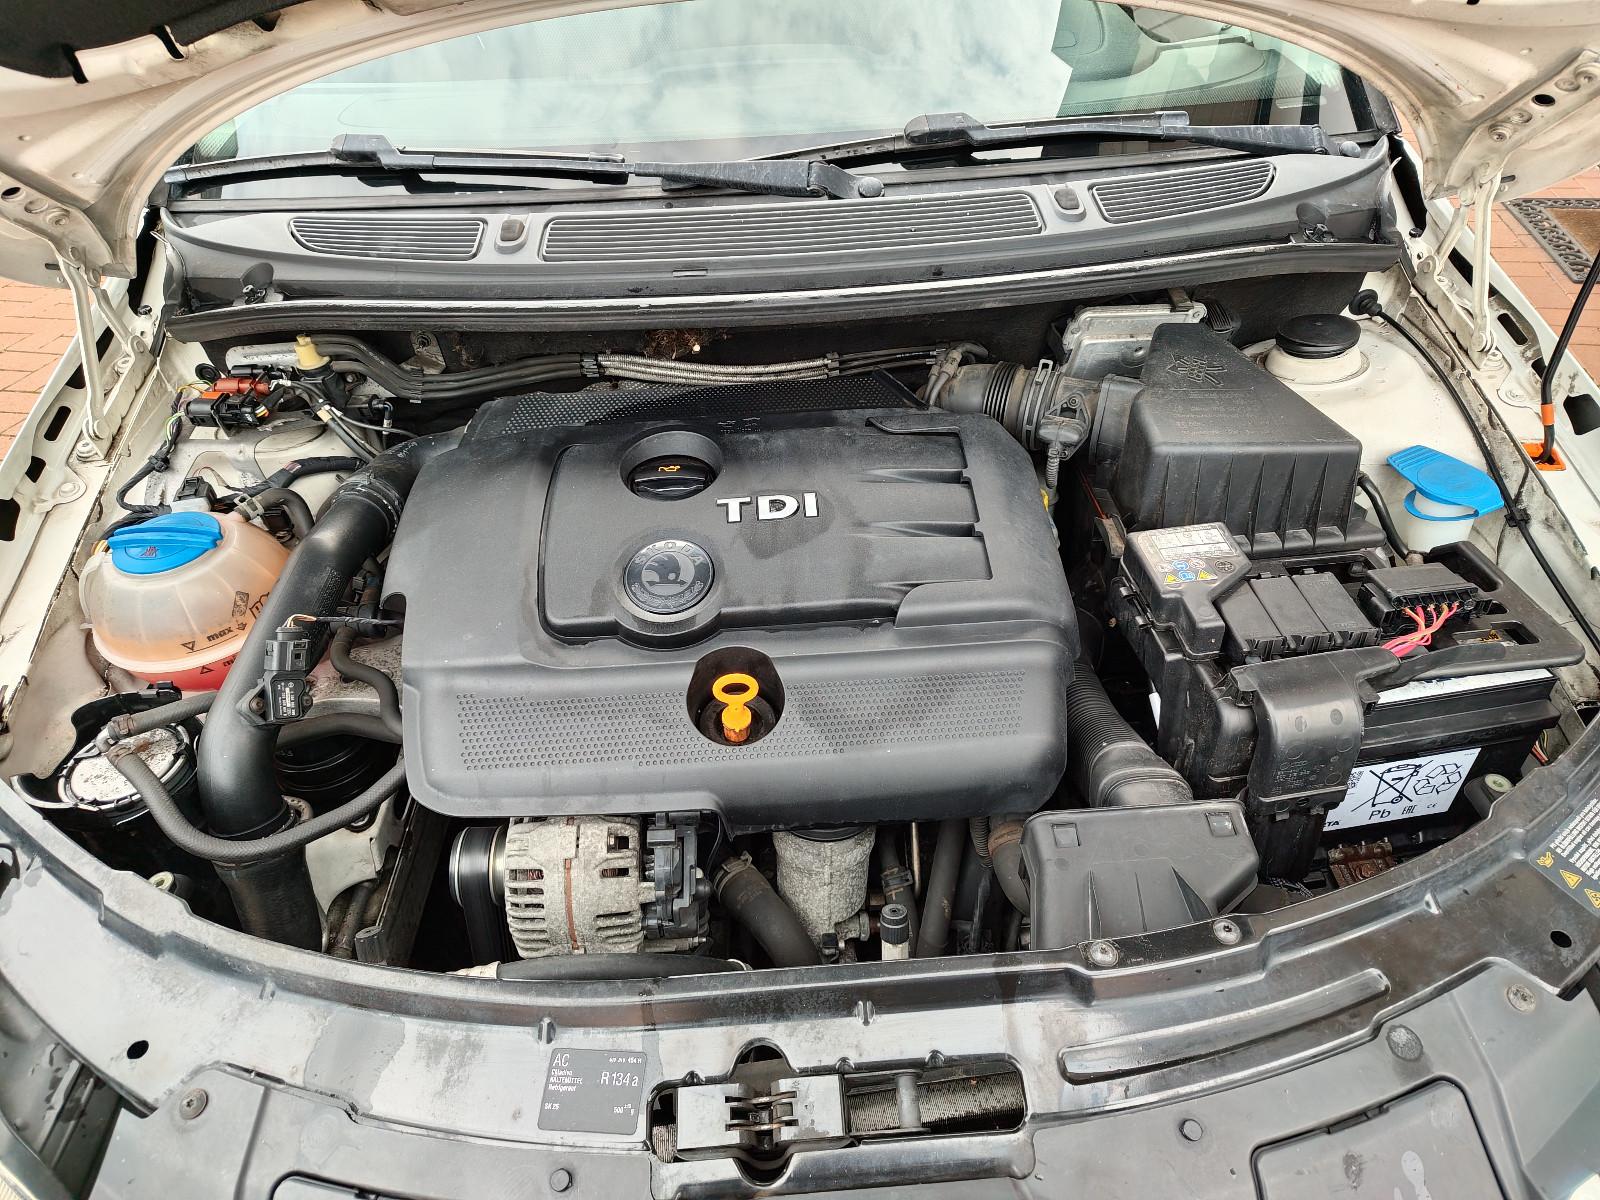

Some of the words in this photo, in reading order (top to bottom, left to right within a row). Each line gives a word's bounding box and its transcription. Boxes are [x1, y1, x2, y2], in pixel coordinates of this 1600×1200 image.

[715, 492, 820, 524] TDI
[206, 626, 233, 642] max
[223, 654, 237, 667] mi
[1368, 810, 1391, 820] Pb
[552, 1053, 570, 1067] AC
